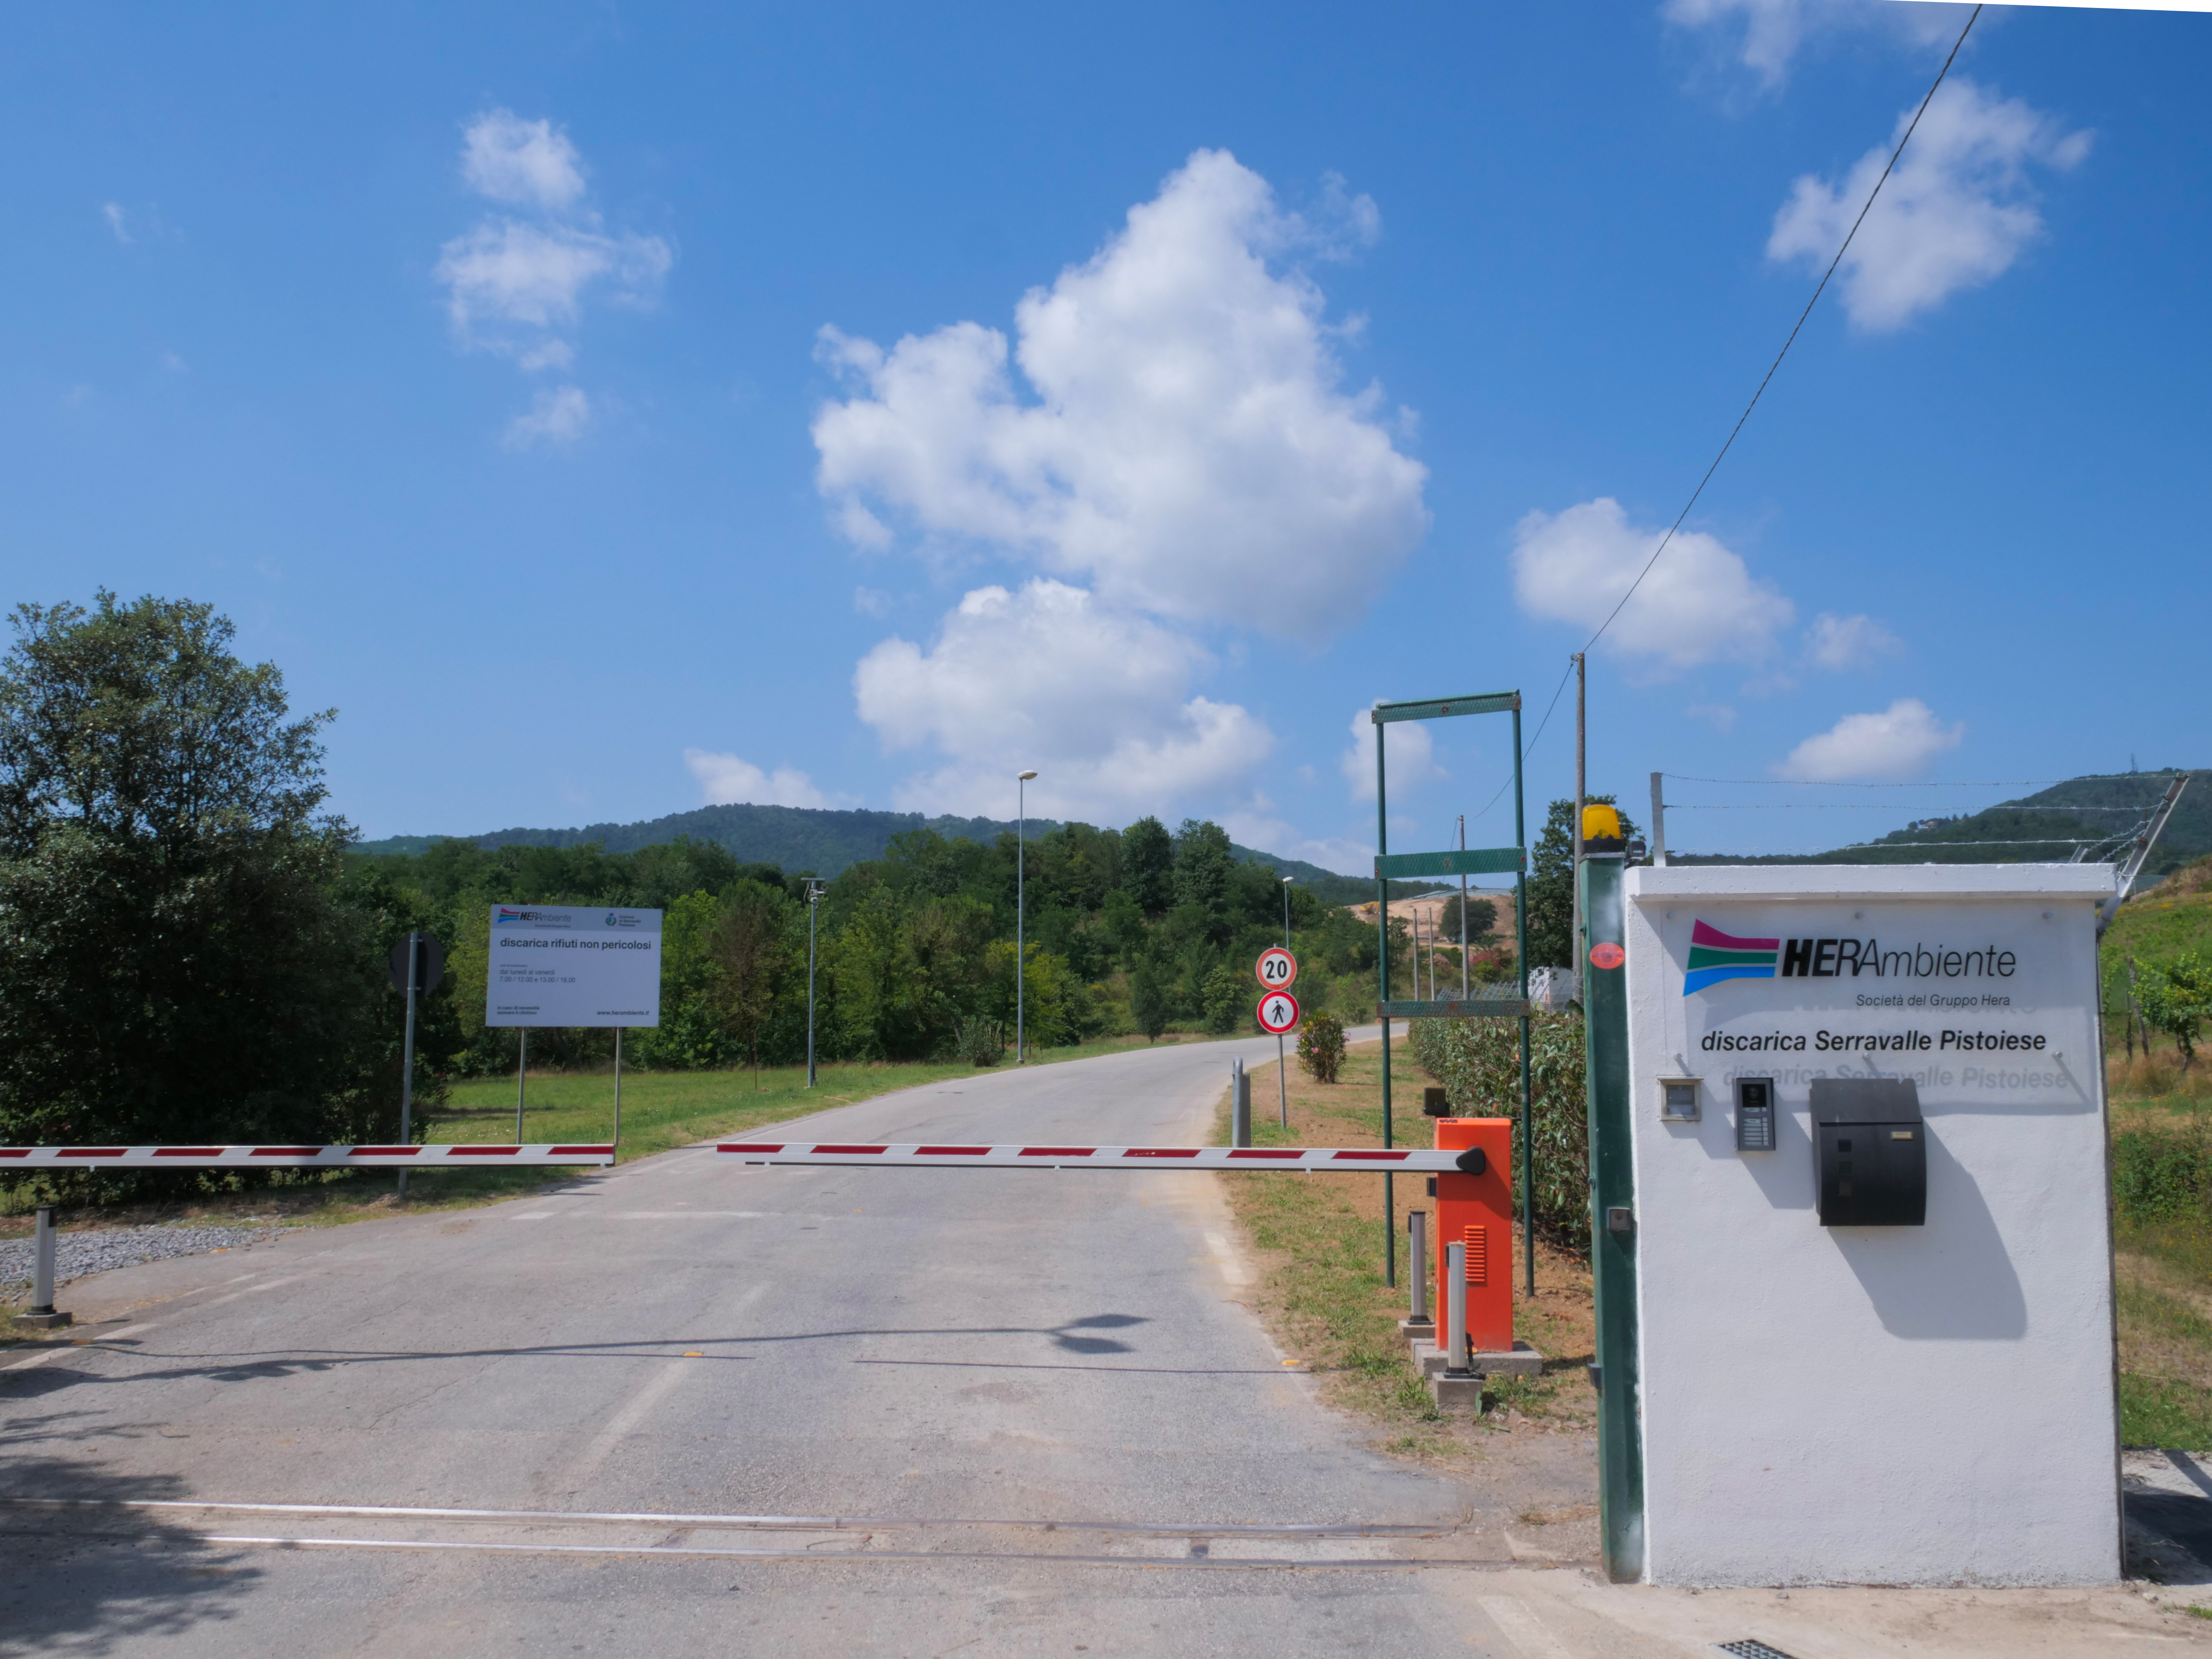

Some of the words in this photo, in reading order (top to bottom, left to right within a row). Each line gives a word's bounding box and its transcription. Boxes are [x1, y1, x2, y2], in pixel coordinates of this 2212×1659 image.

[519, 912, 572, 922] HERAmbiente
[500, 938, 548, 948] discarica
[551, 939, 578, 948] rifiuti
[602, 940, 651, 951] pericolosi
[1781, 939, 2016, 978] HERAmbiente
[1265, 960, 1287, 979] 20
[1856, 994, 1904, 1006] Società
[1907, 994, 1927, 1006] del
[1930, 994, 1978, 1009] Gruppo
[1981, 994, 2010, 1006] Hera
[1701, 1031, 1806, 1051] discarica
[1815, 1030, 1932, 1051] Serravalle
[1940, 1030, 2046, 1050] Pistoiese
